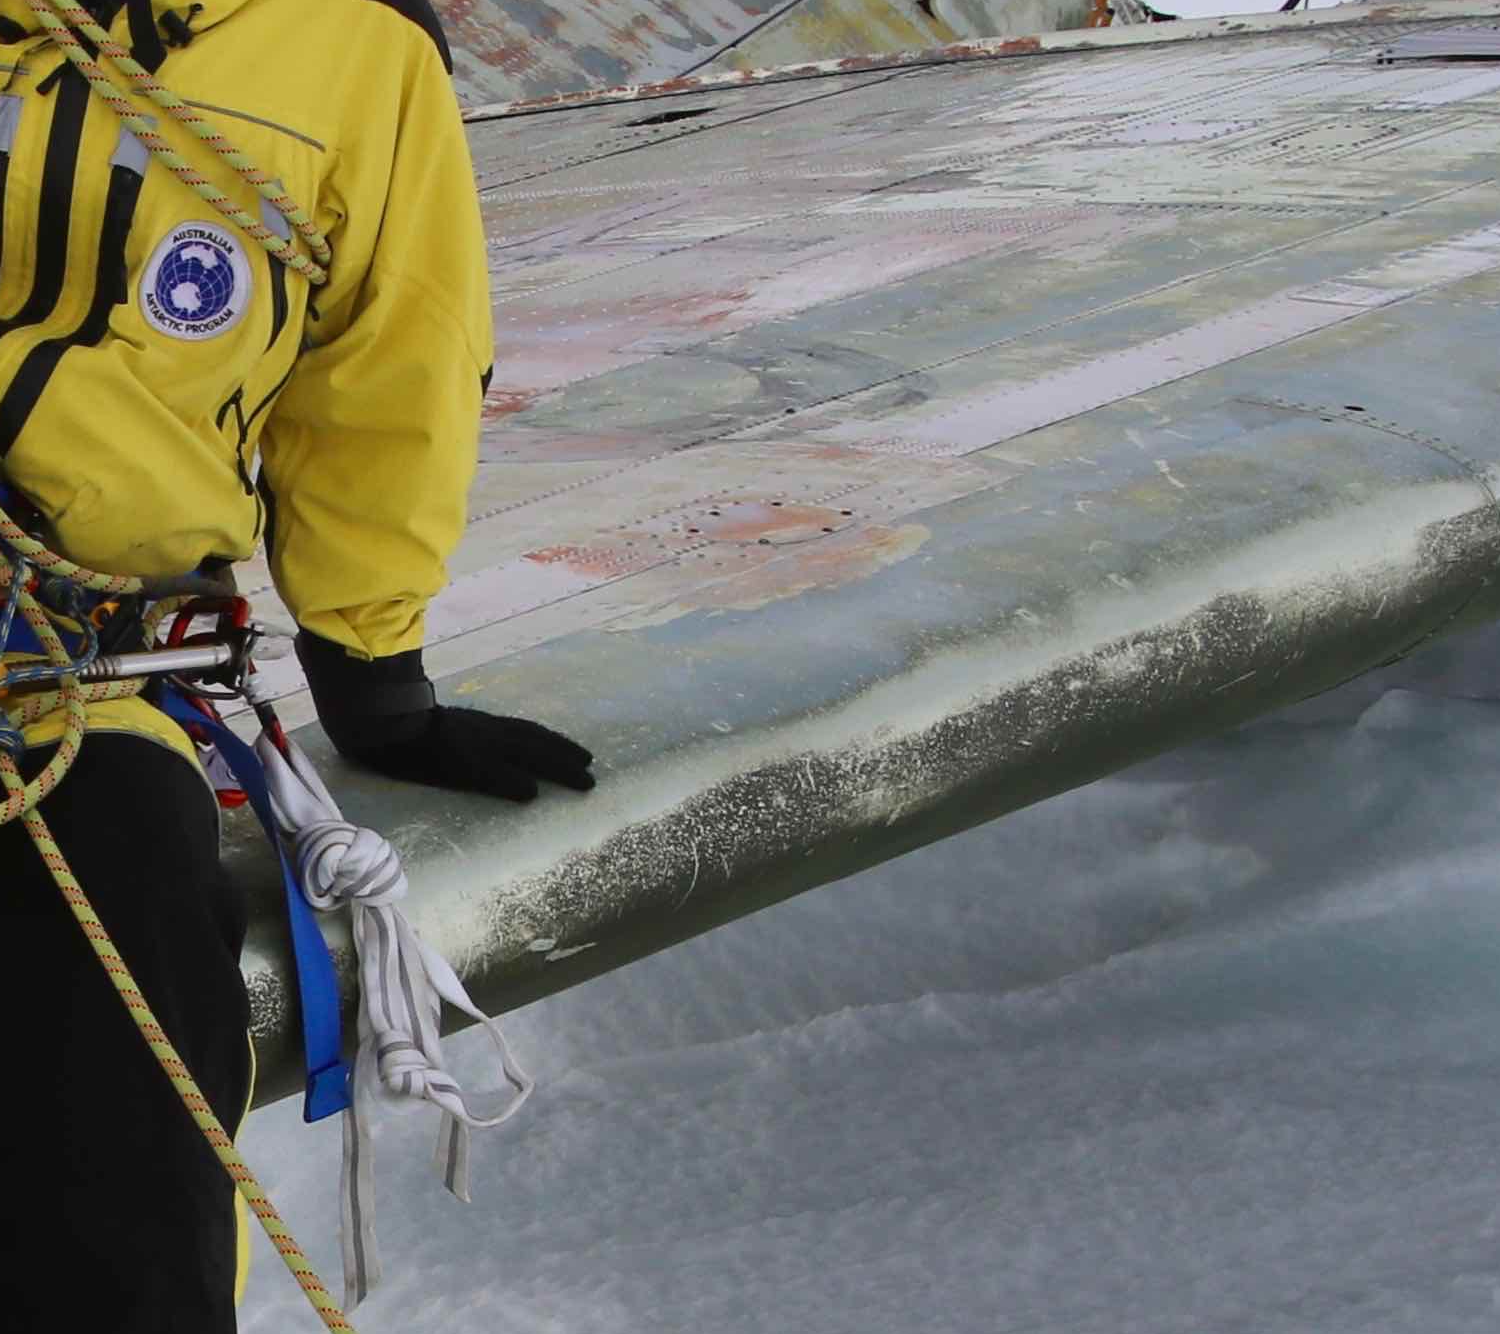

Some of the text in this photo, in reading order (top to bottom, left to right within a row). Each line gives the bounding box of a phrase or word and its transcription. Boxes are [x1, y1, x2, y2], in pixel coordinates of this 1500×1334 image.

[173, 228, 235, 255] AUSTRALIAN
[146, 293, 235, 333] ANTARCTIC PROGRAM
